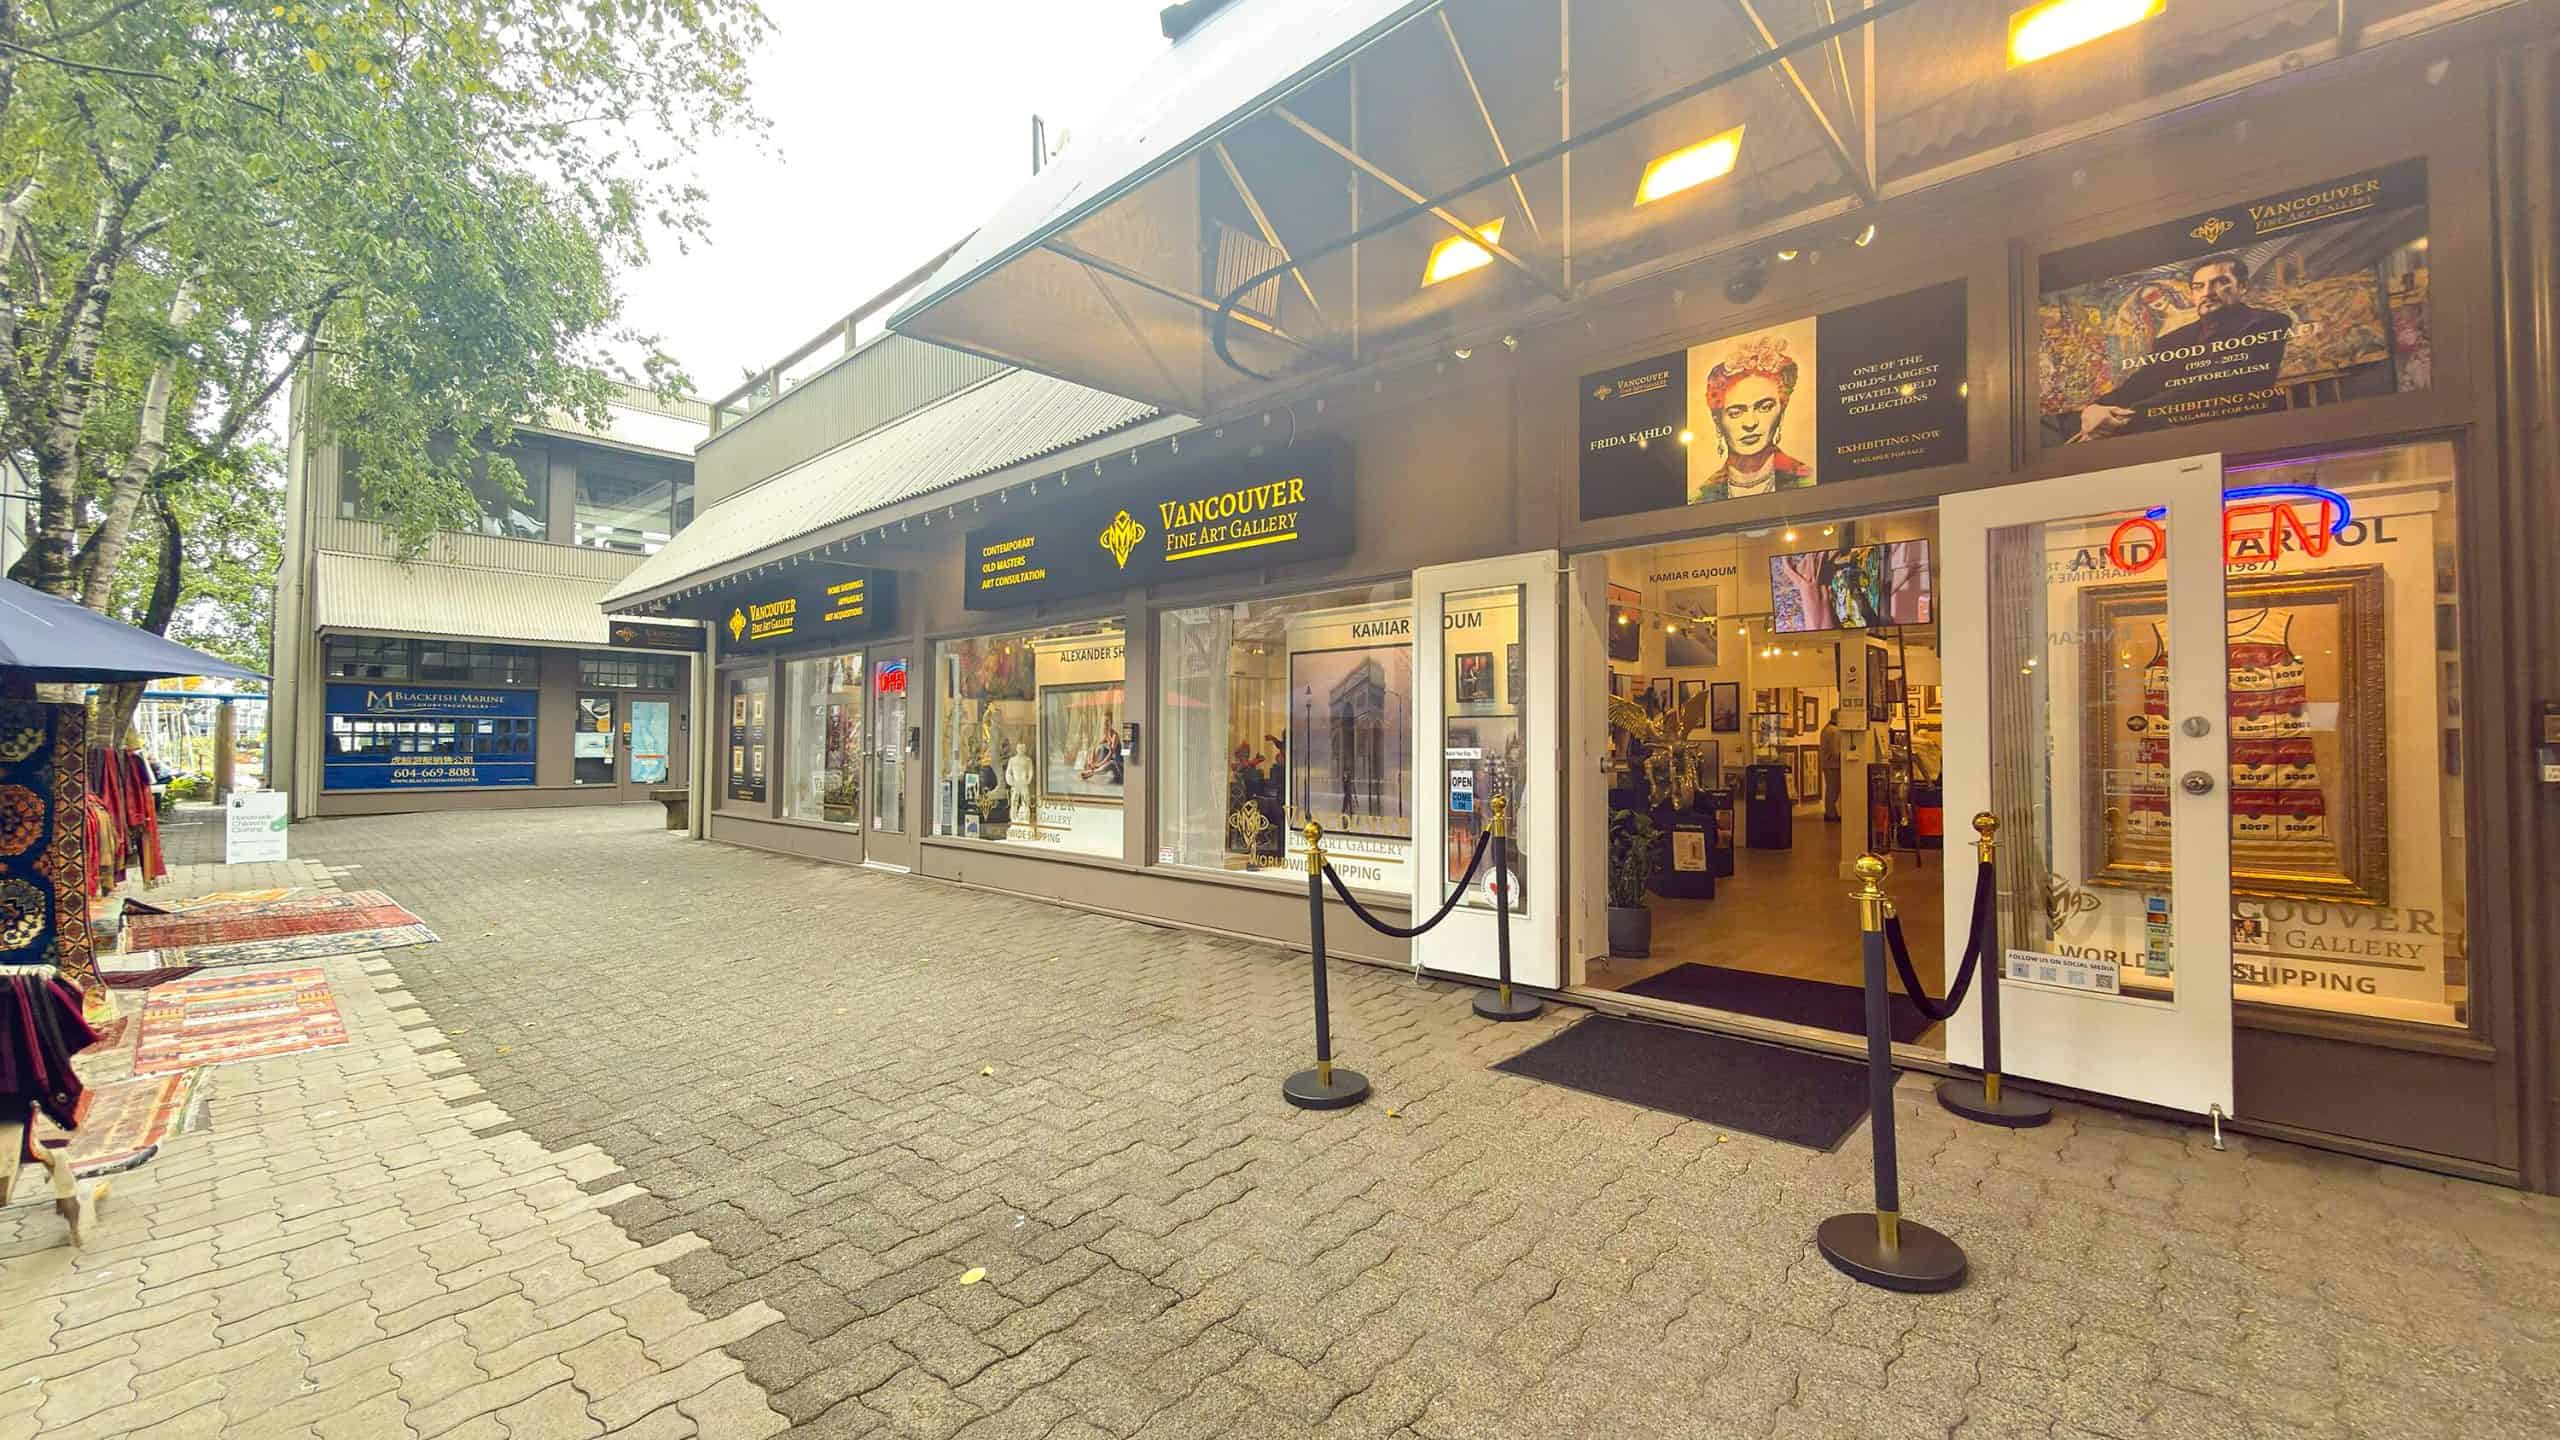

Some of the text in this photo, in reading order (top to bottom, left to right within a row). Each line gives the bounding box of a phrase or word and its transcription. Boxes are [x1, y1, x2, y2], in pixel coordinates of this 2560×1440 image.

[2248, 178, 2382, 220] VANCOUVER
[1853, 354, 1923, 376] ONE OF THE
[2121, 343, 2206, 371] DAVOOD
[1617, 369, 1669, 389] VANCOUVER
[1839, 364, 1939, 391] WORLD'S LARGEST
[2164, 362, 2271, 388] CRYPTOREALISM
[1840, 378, 1937, 405] PRIVATELY ELD
[2147, 385, 2287, 417] EXHIBITING NOW
[1848, 393, 1929, 415] COLLECTIONS
[1590, 425, 1673, 450] FRIDA KAHLO
[1838, 430, 1941, 454] EXHIBITING NOW
[1160, 477, 1305, 530] VANCOUVER
[1166, 511, 1298, 551] FINE ART GALLERY
[2110, 499, 2331, 573] OEN
[983, 535, 1035, 557] CONTEMPORARY
[983, 555, 1026, 573] OLD MASTERS
[1649, 565, 1737, 583] KAMIAR GAJOUM
[982, 567, 1046, 590] ART CONSULTATION
[749, 599, 796, 620] VANCOUVER
[772, 616, 794, 630] GALLERY
[1352, 611, 1482, 638] KAMIAR OUM
[1060, 647, 1111, 663] ALEXANDER
[880, 671, 907, 693] OPEN
[2275, 670, 2303, 680] SOUP
[395, 691, 457, 702] BLACKFISH
[460, 692, 504, 704] MARINE
[393, 767, 476, 778] 604-669-8081
[1452, 777, 1472, 788] OPEN
[2239, 773, 2270, 781] SOUP
[2284, 772, 2315, 781] SOUP
[1452, 792, 1472, 802] COME
[2239, 823, 2270, 831] SOUP
[2285, 823, 2316, 831] SOUP
[1345, 839, 1404, 856] GALLERY
[1334, 863, 1382, 881] HIPPING
[2285, 929, 2425, 959] GALLERY
[2008, 953, 2115, 972] FOLLOW US ON SOCIAL MEDIA
[2232, 962, 2377, 995] SHIPPING
